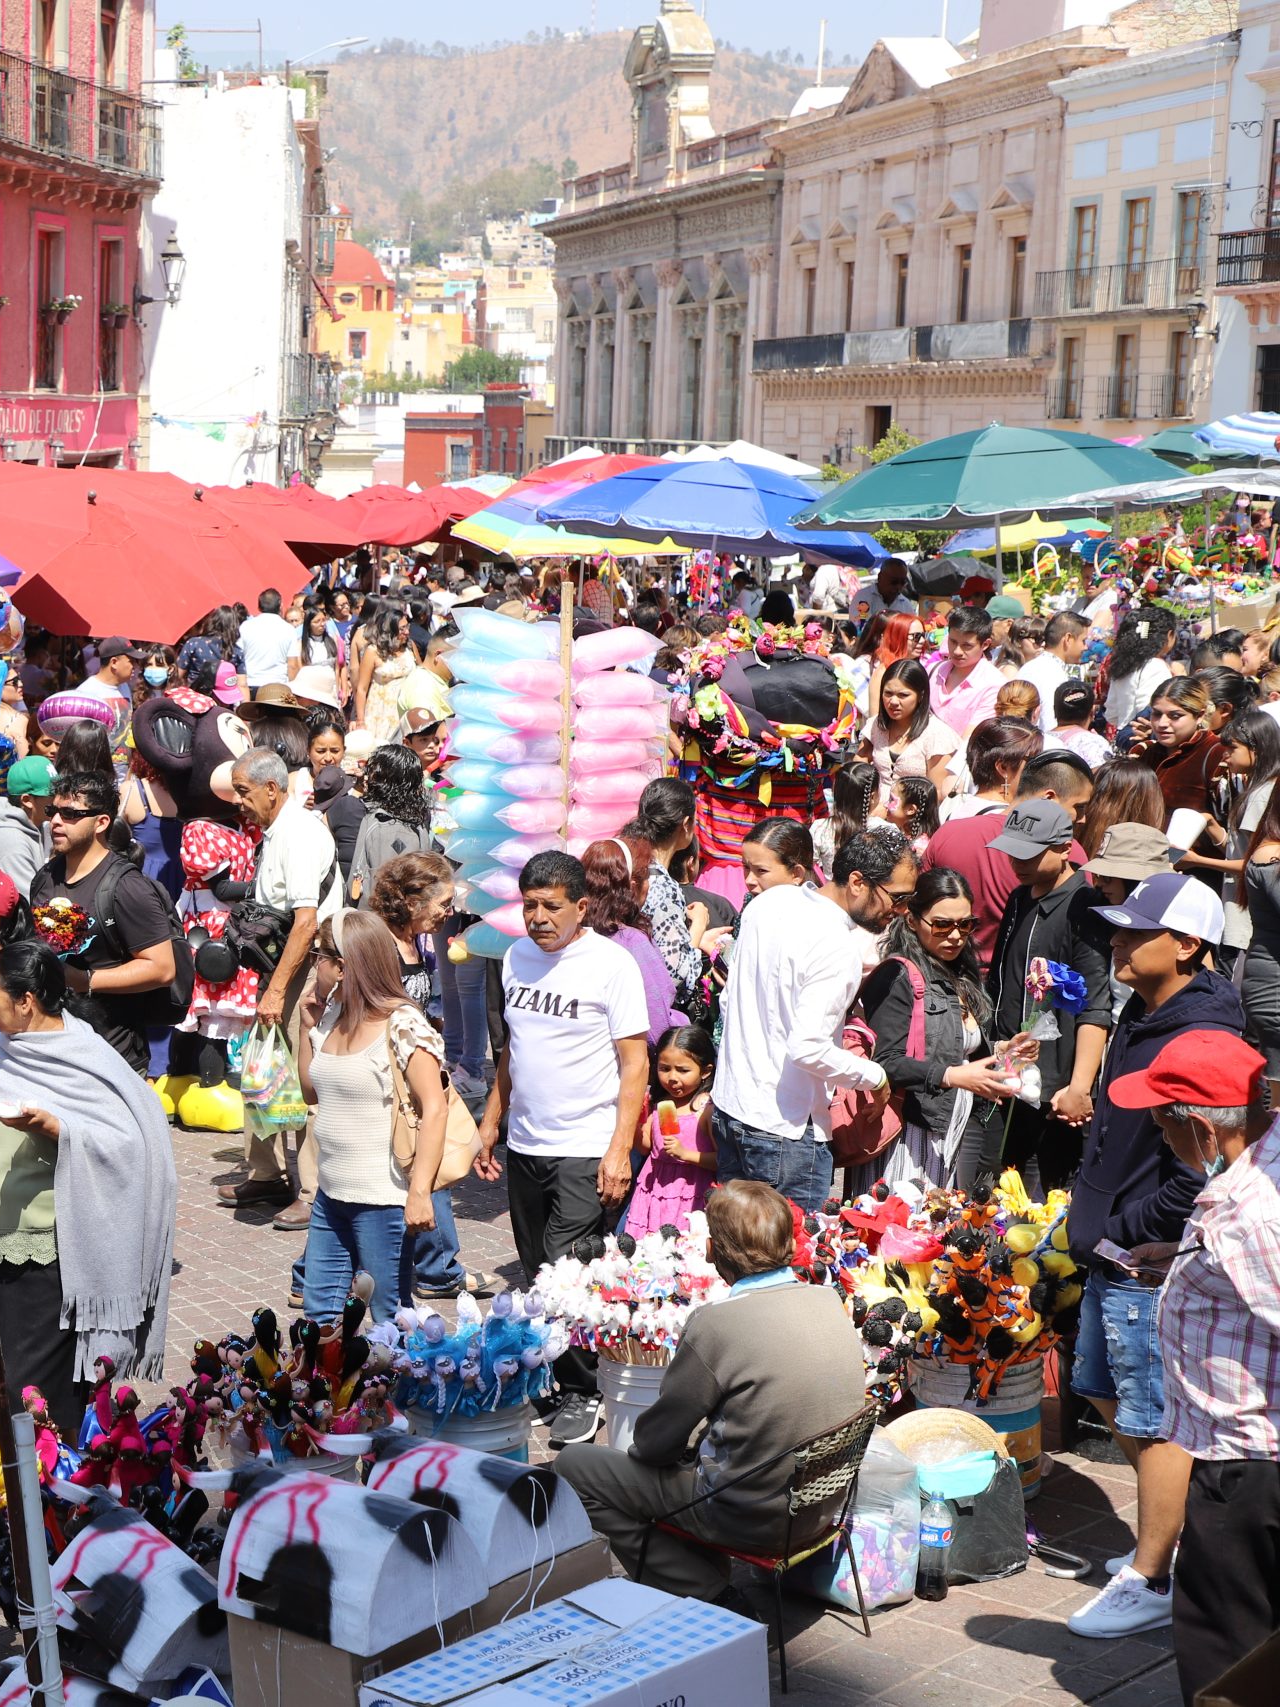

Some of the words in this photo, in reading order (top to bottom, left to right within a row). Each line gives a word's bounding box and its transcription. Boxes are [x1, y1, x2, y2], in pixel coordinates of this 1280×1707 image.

[28, 409, 42, 434] DE
[512, 986, 579, 1019] TAMA
[538, 1629, 572, 1643] 360
[555, 1667, 588, 1683] 360
